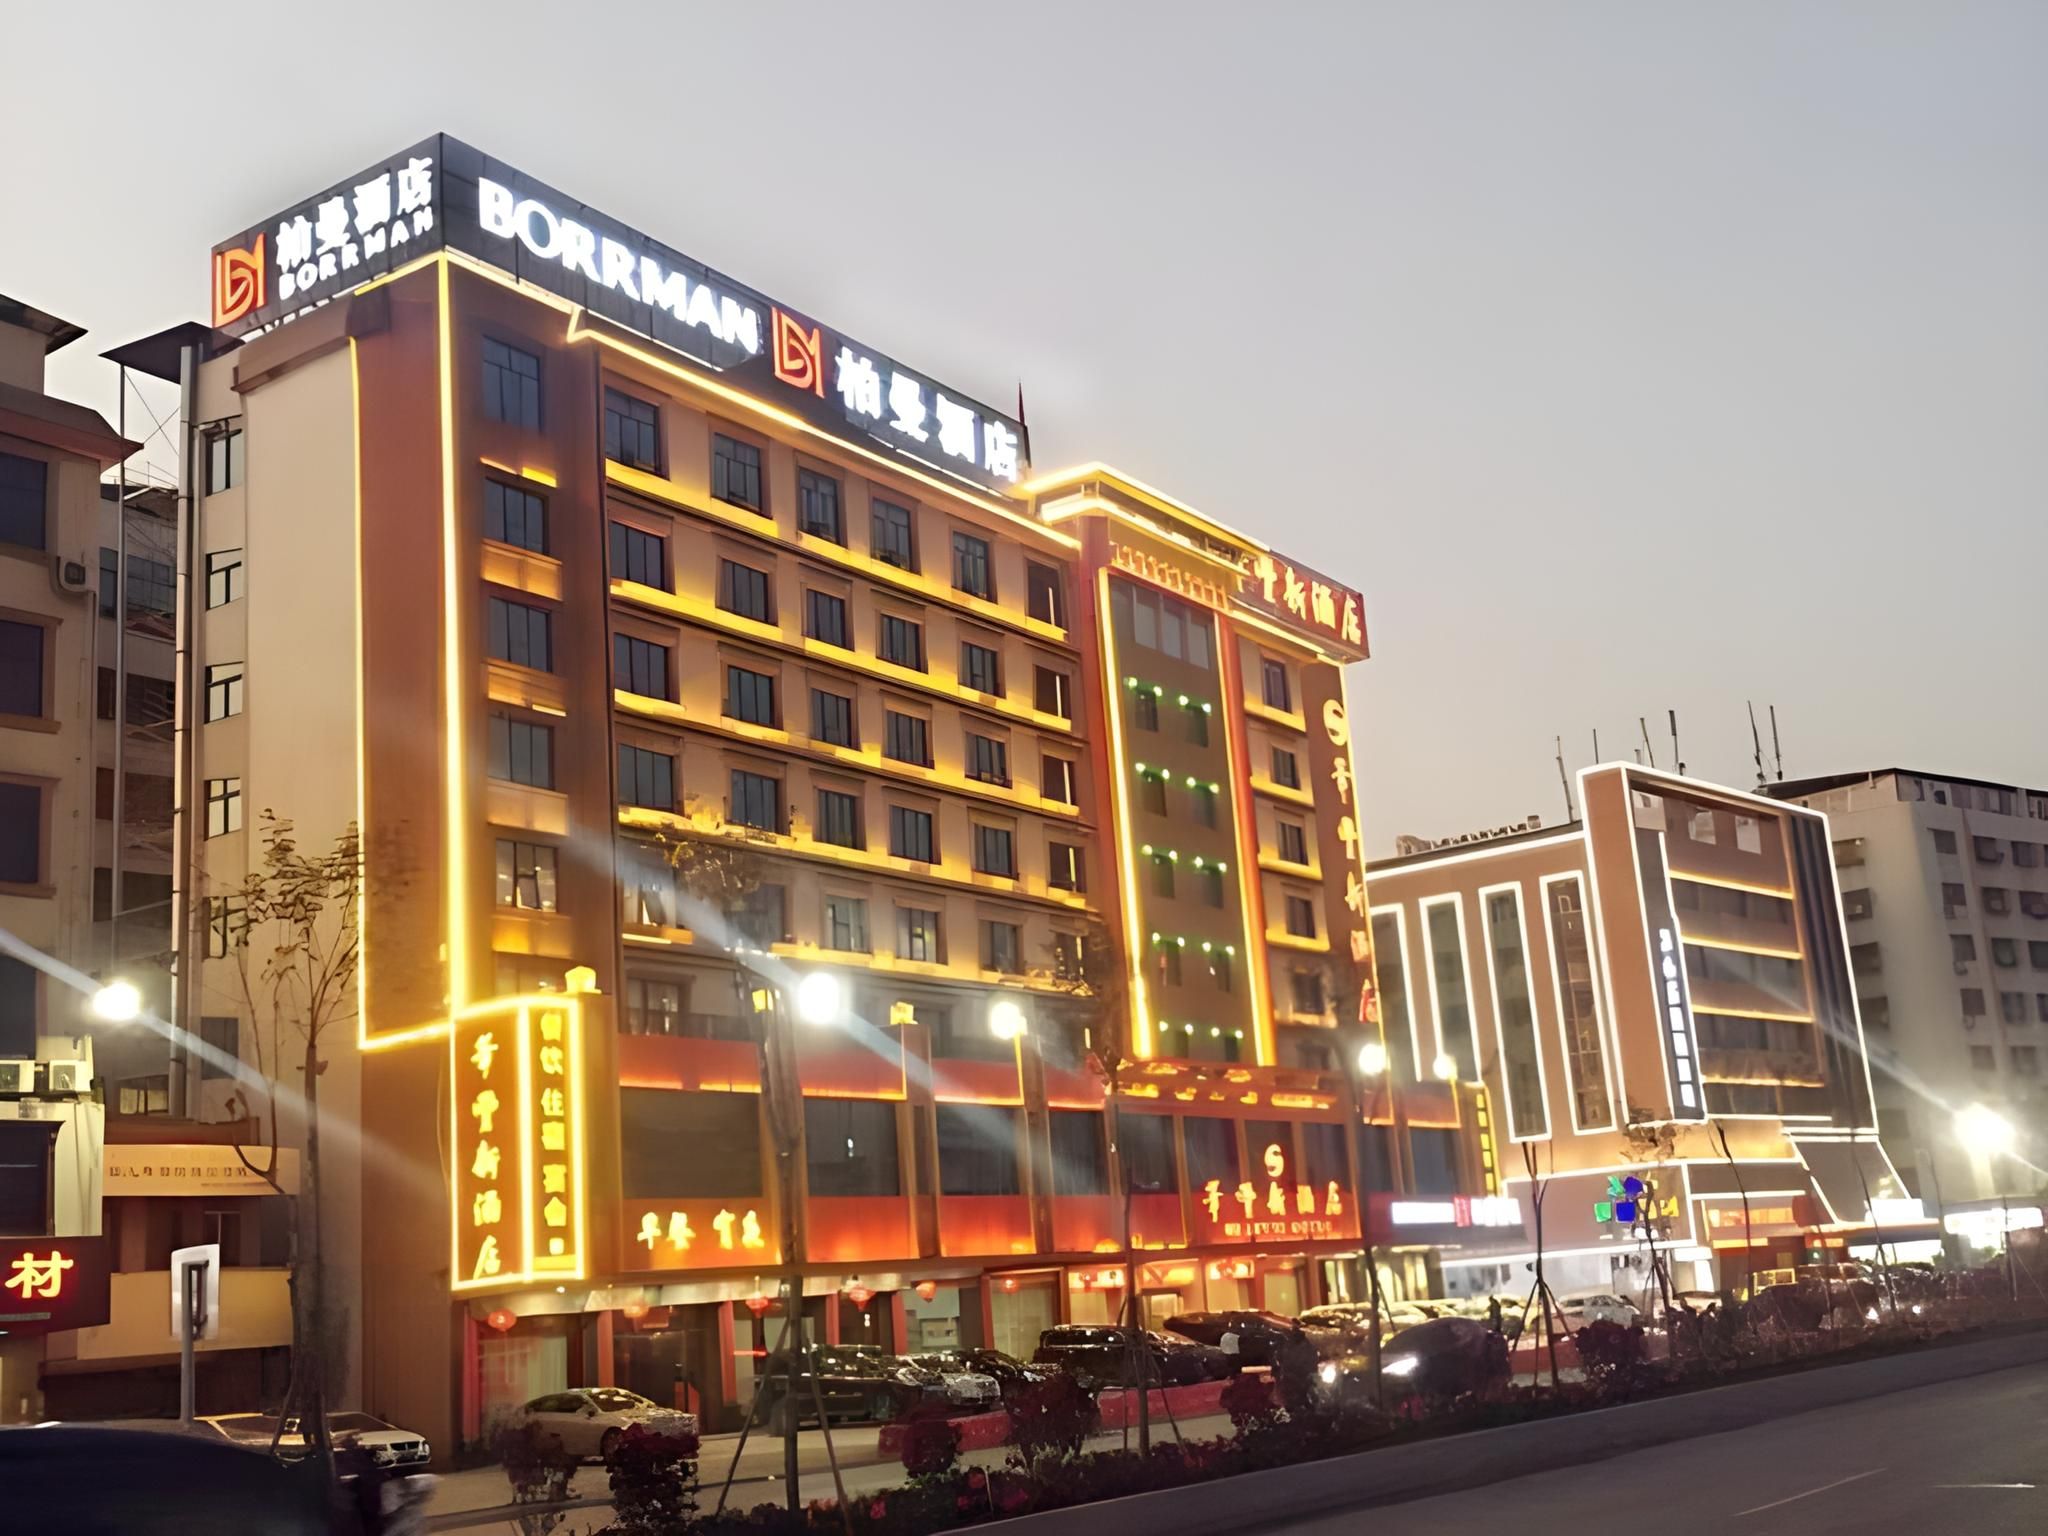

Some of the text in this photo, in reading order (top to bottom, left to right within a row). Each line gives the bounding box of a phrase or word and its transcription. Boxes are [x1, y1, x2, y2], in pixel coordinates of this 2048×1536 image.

[275, 156, 433, 274] 柏曼酒店
[278, 205, 434, 301] BORRMAN
[478, 176, 759, 354] BORRMAN
[834, 345, 1018, 483] 柏曼酒店
[4, 1250, 74, 1299] 材
